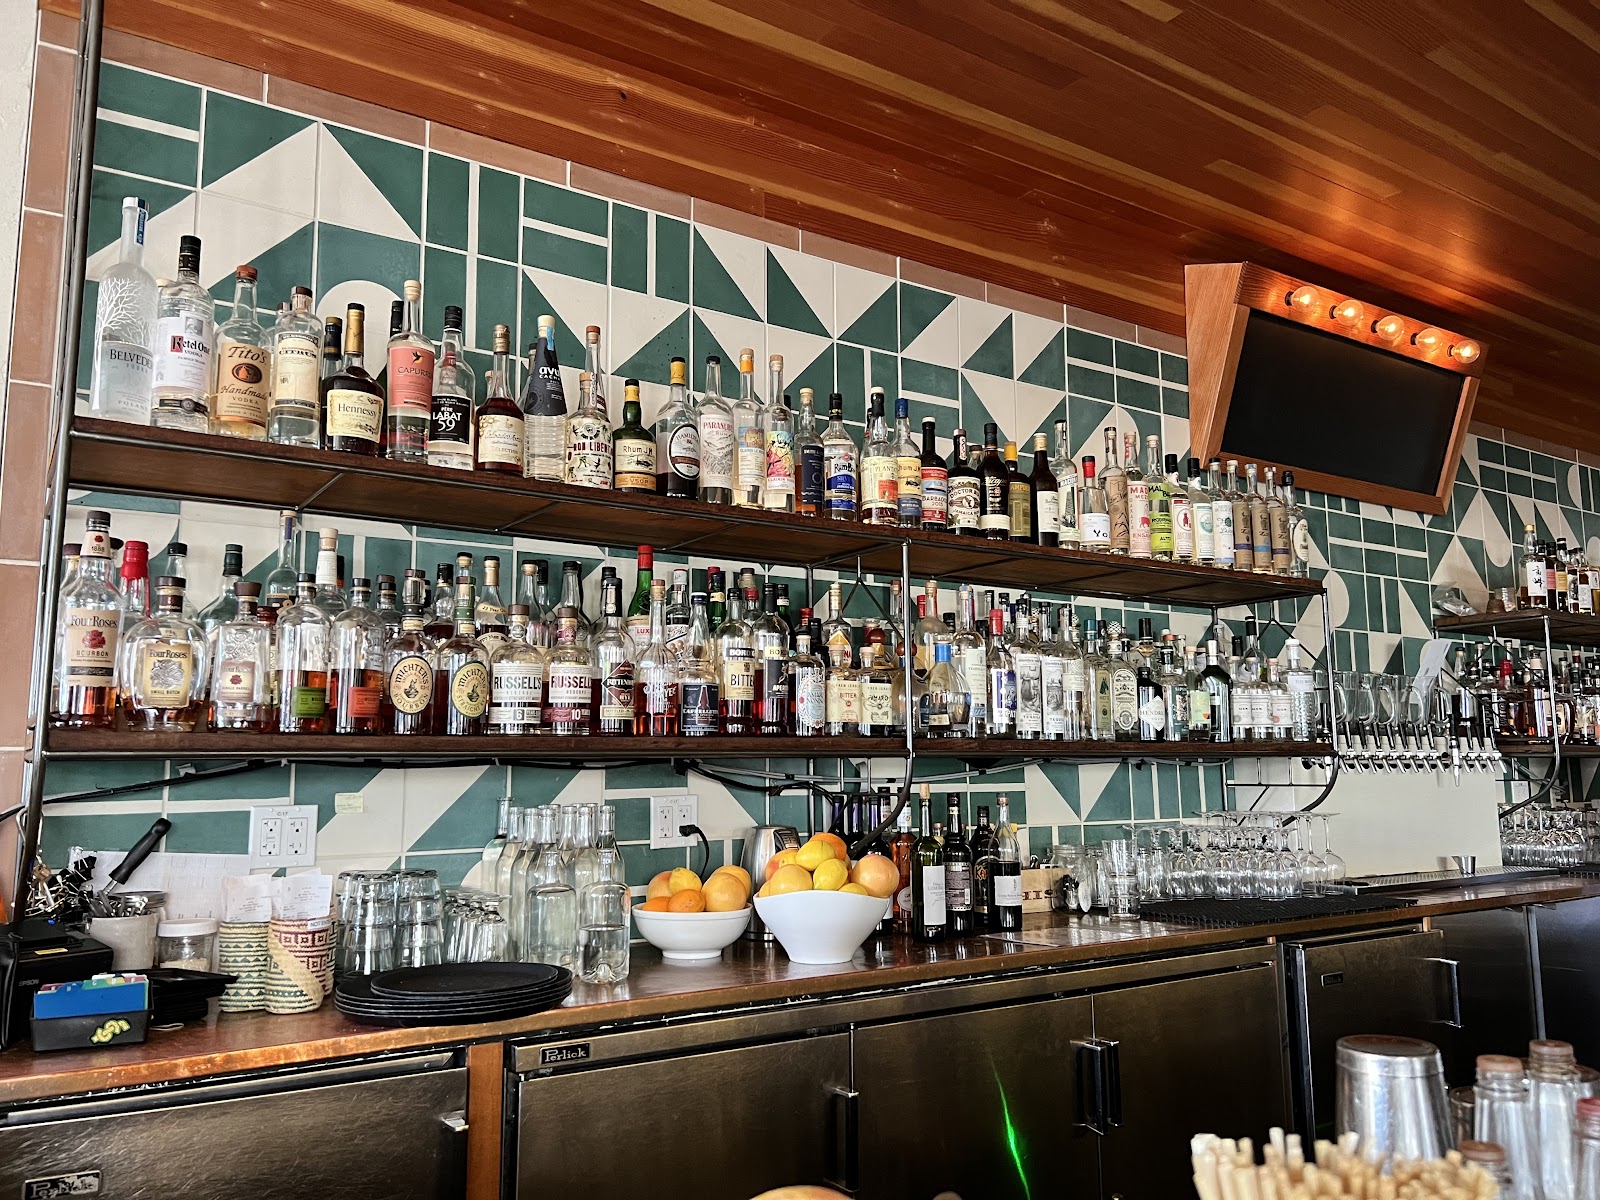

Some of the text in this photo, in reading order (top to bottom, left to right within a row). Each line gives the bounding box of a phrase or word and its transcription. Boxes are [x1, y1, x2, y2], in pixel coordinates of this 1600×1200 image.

[171, 335, 197, 351] Ketel
[227, 345, 268, 364] Tito's
[232, 396, 260, 405] VODKA
[338, 403, 377, 418] Hennessy
[432, 411, 462, 422] LABAT
[437, 419, 456, 432] 59
[622, 445, 643, 453] Rhum
[949, 488, 973, 499] DOCTOR
[70, 614, 118, 629] Four Roses
[636, 626, 650, 634] LUX
[149, 649, 188, 659] Four Roses
[395, 663, 429, 686] MICHTER'S
[494, 676, 542, 690] RUSSELL'S
[516, 709, 523, 720] 6
[571, 708, 581, 720] 10
[544, 1047, 587, 1063] Perlick
